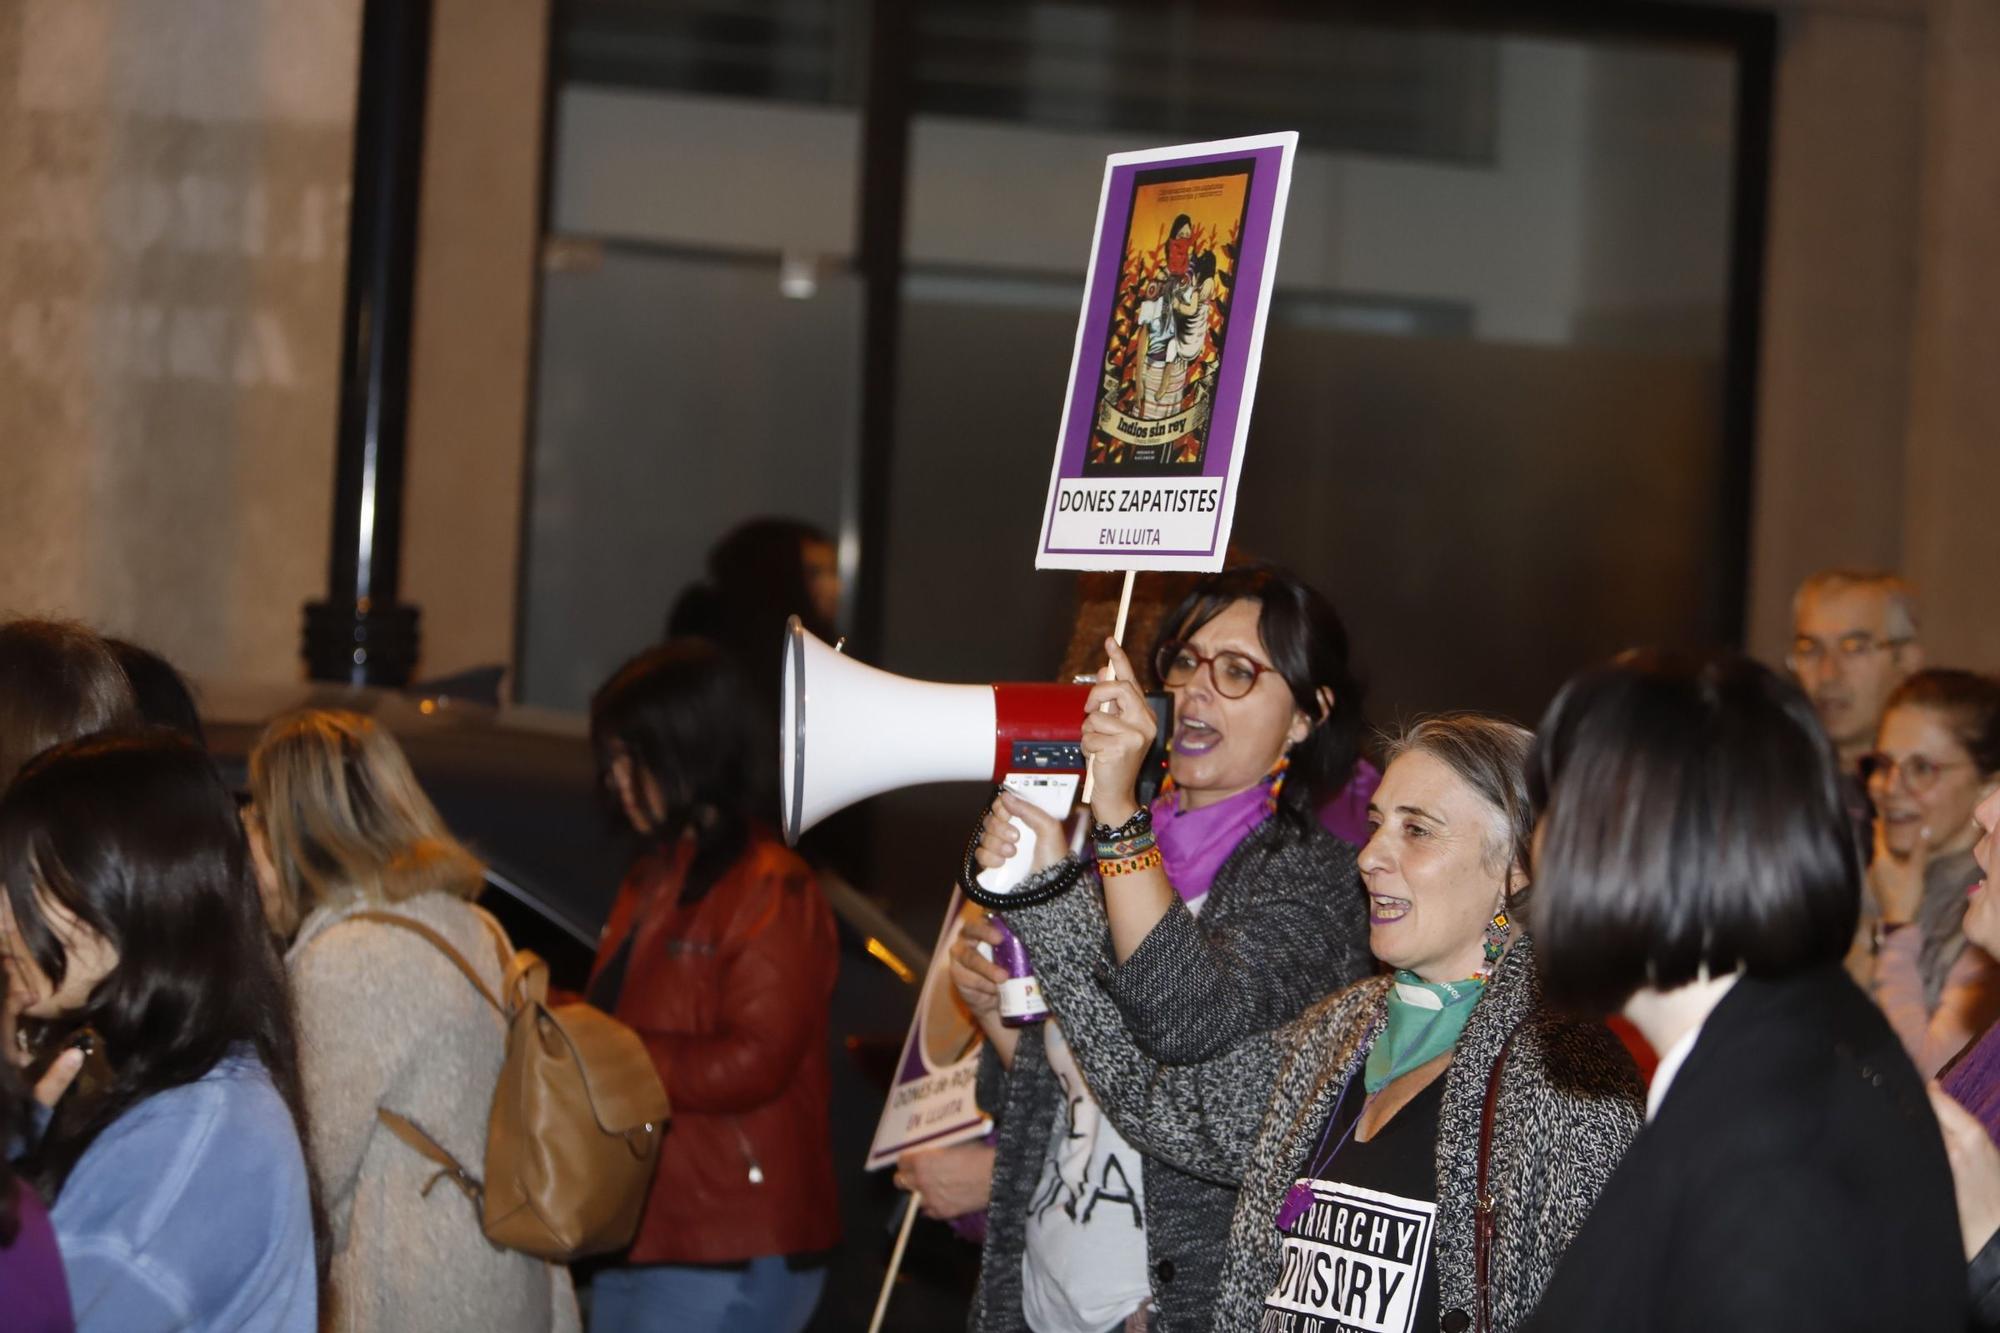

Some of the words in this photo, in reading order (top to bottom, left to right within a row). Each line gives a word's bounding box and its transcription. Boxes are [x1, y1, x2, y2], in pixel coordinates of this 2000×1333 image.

[1116, 417, 1148, 438] Indios
[1149, 420, 1166, 437] sin
[1168, 417, 1187, 434] rey
[1059, 489, 1116, 512] DONES
[1118, 488, 1218, 513] ZAPATISTES
[1098, 528, 1116, 545] EN
[1118, 528, 1160, 545] LLUITA
[1291, 1202, 1415, 1260] TRIARCHY
[1271, 1246, 1405, 1325] DVISORY
